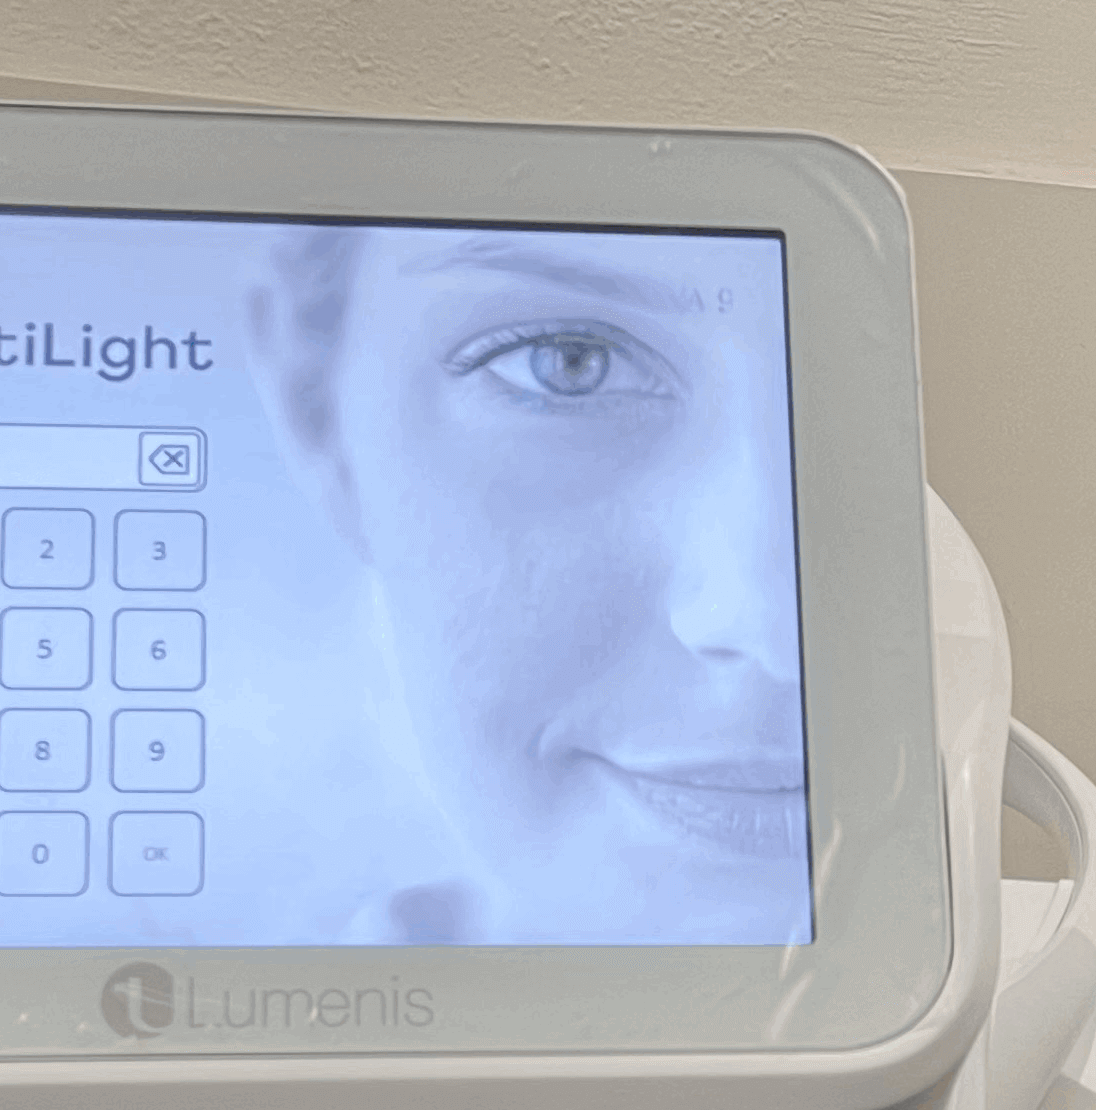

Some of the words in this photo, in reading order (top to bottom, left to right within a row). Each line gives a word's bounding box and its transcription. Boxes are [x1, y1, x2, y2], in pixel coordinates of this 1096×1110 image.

[39, 538, 55, 559] 2
[152, 541, 167, 561] 3
[36, 638, 53, 660] 5
[150, 639, 168, 661] 6
[34, 740, 52, 761] 8
[149, 740, 165, 762] 9
[31, 843, 50, 864] 0
[143, 846, 169, 862] OK
[187, 974, 435, 1028] Lumenis
